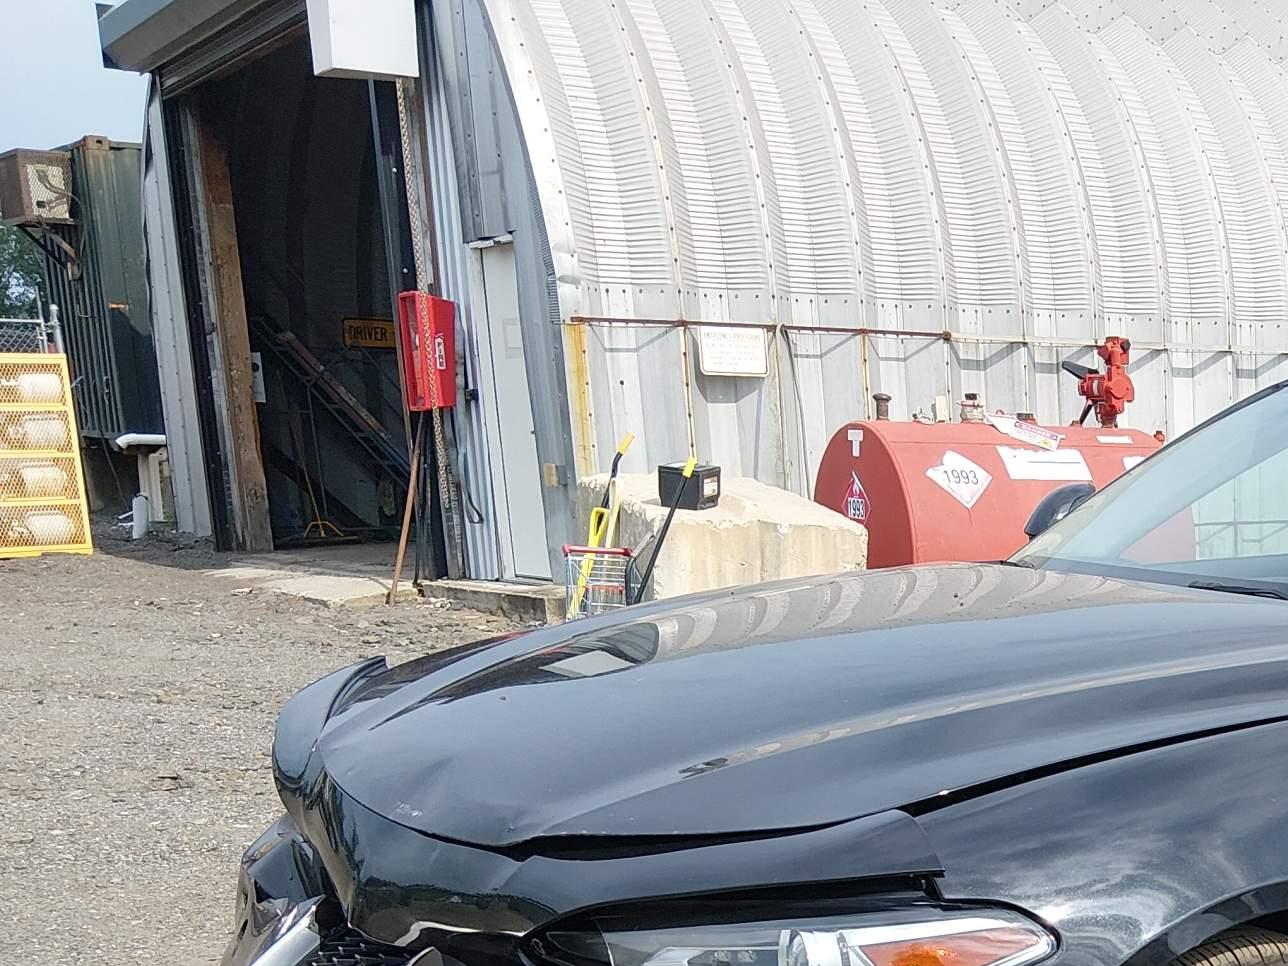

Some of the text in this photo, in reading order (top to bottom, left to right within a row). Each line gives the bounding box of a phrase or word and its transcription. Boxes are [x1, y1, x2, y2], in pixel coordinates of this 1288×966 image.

[348, 325, 387, 342] DRIVER
[437, 341, 445, 368] FIRE
[943, 469, 979, 485] 1993
[848, 499, 865, 518] 1993
